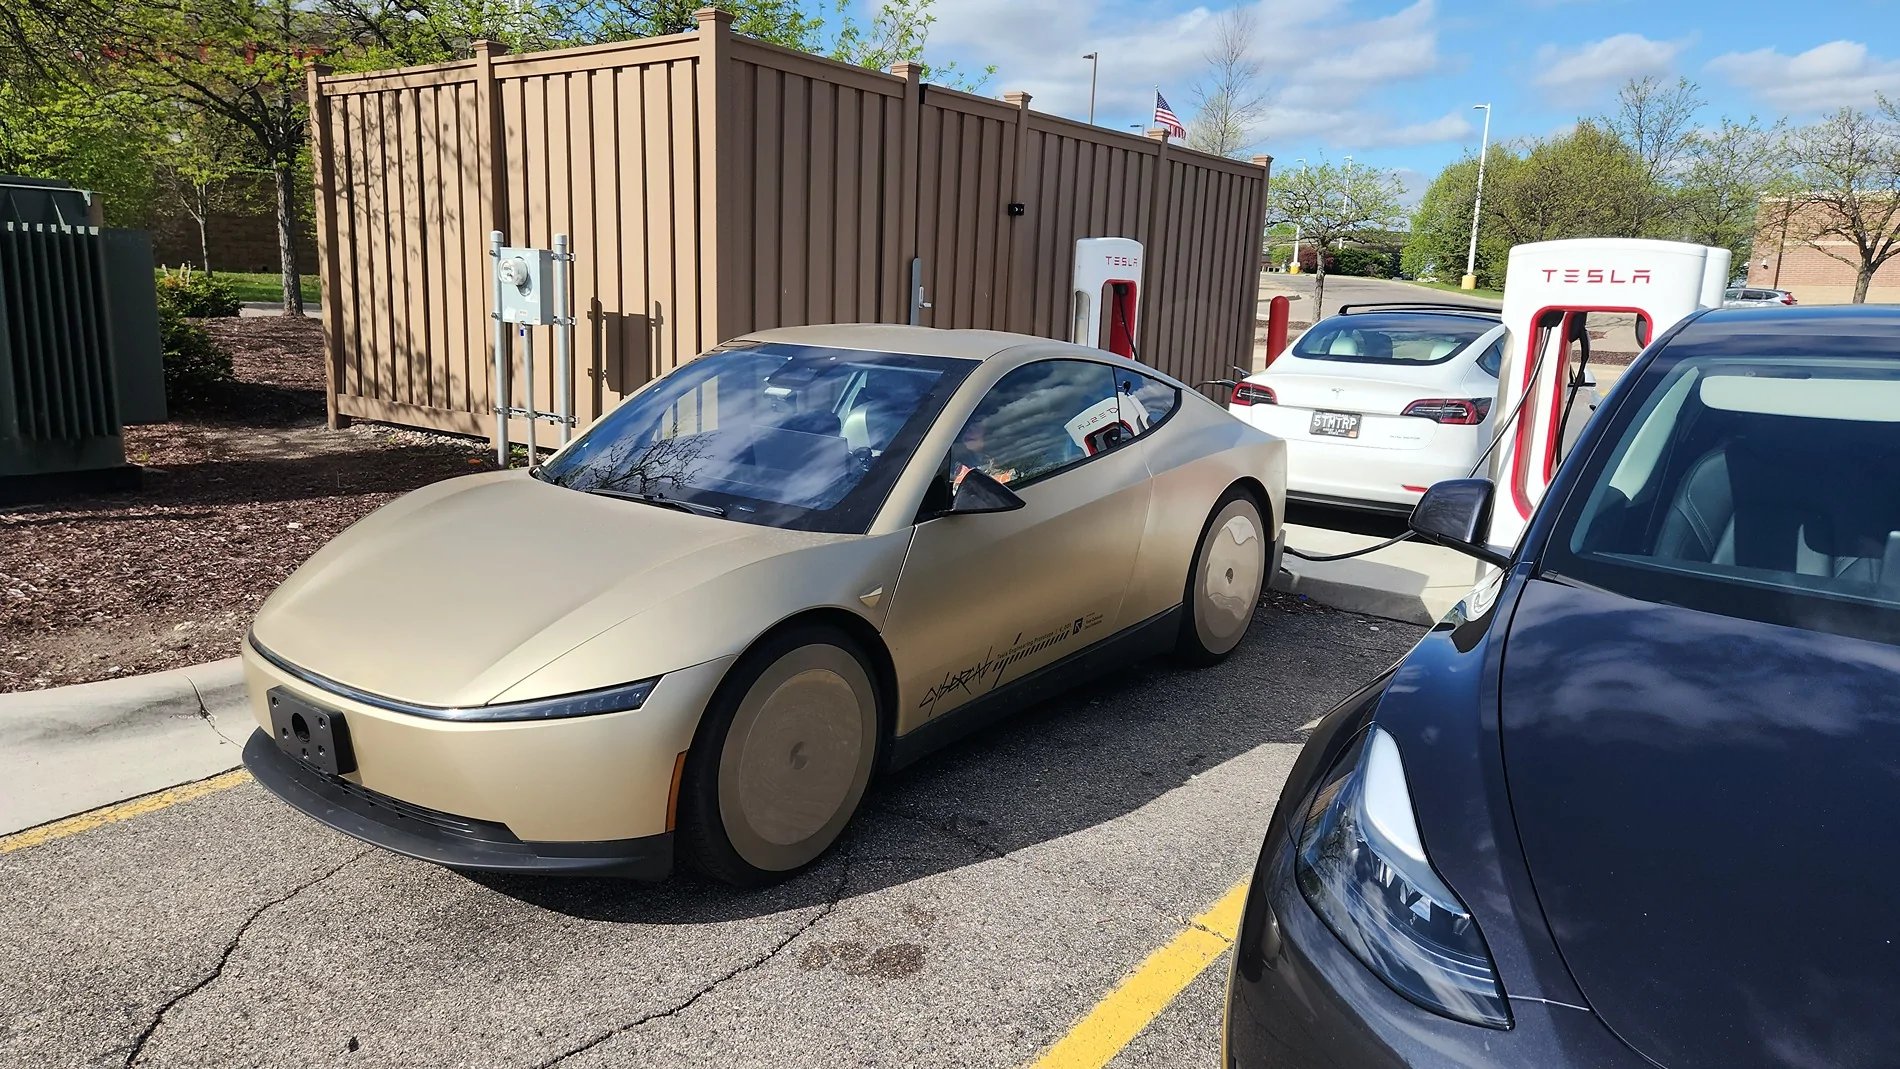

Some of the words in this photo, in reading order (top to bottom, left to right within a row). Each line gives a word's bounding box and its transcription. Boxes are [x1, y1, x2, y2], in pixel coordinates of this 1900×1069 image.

[1105, 255, 1138, 267] TESLA
[1542, 269, 1652, 284] TESLA
[1008, 640, 1034, 655] Engineering
[1034, 631, 1054, 643] Prototype
